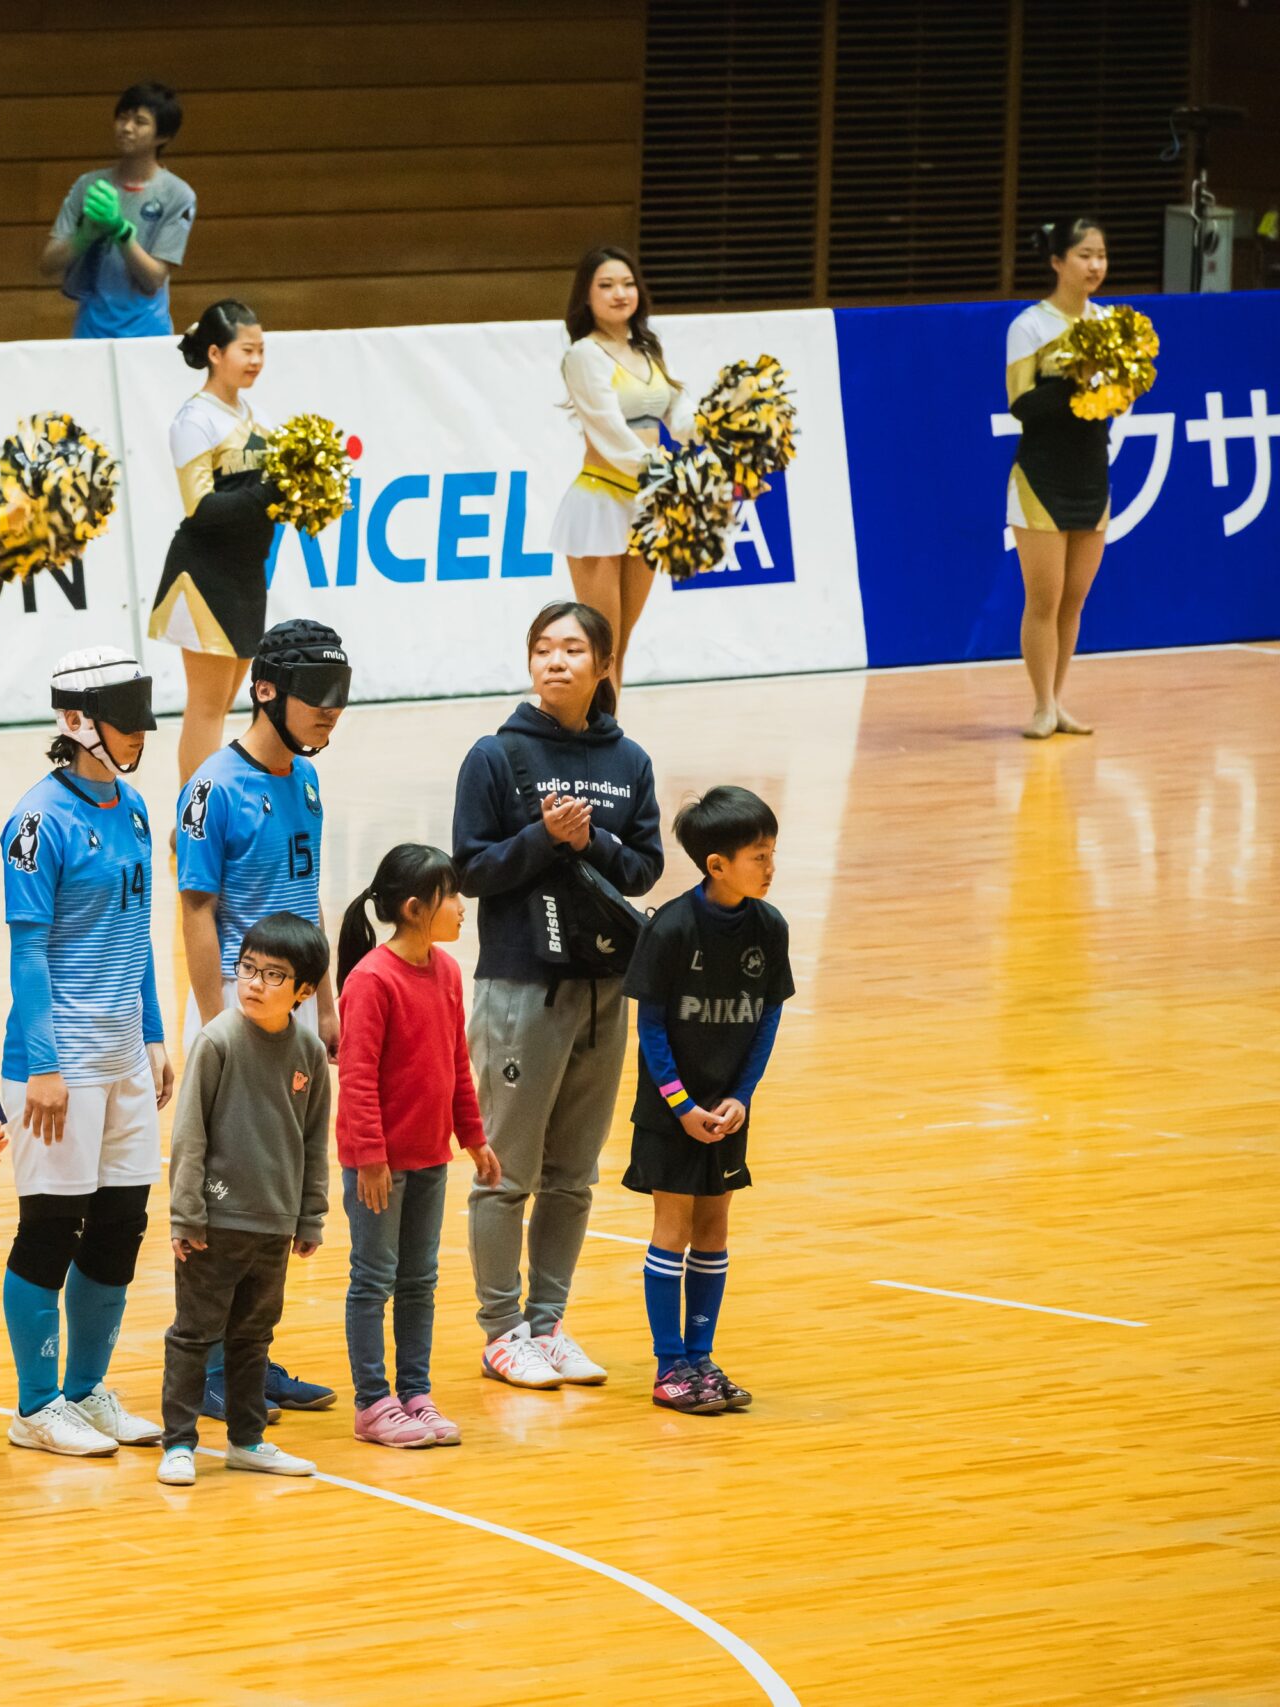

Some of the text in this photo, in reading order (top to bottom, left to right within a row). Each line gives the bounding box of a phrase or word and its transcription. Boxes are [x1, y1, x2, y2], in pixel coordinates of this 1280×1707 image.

[288, 833, 314, 880] 15
[121, 862, 144, 911] 14
[542, 895, 561, 953] Bristol
[205, 1178, 228, 1200] irby
